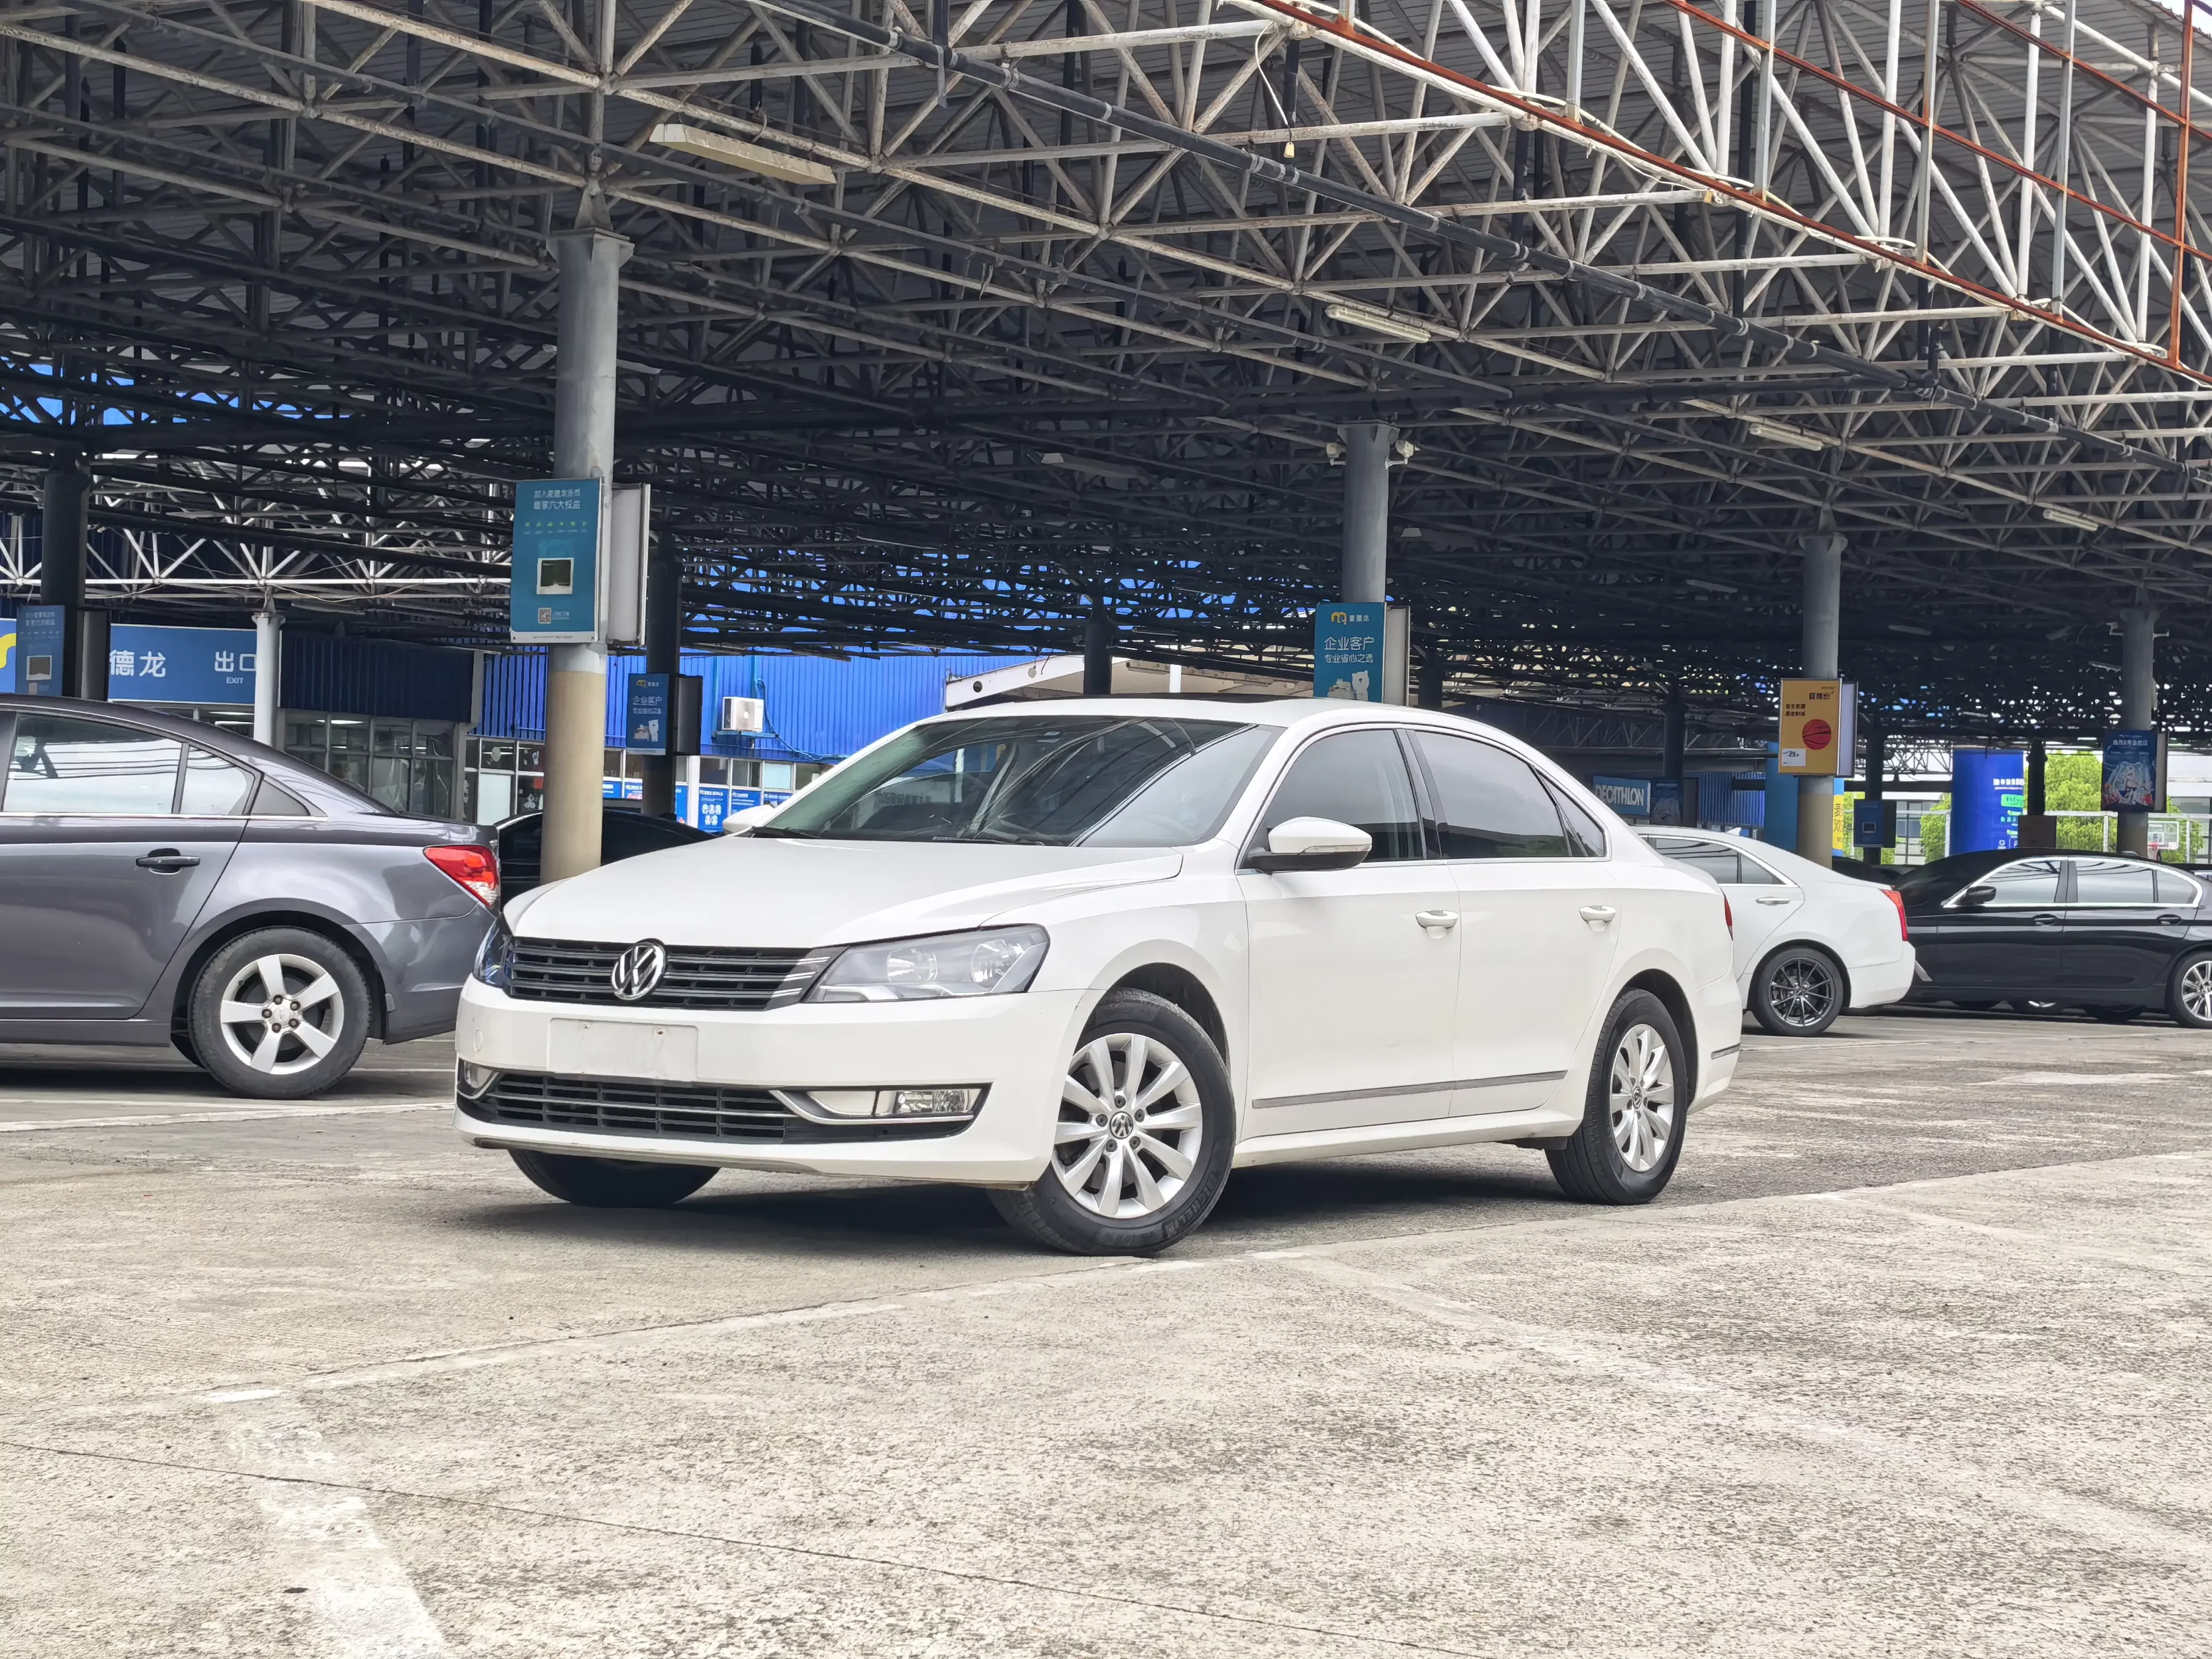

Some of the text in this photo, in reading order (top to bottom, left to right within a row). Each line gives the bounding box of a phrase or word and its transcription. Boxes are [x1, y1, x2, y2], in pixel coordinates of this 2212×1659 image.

[1324, 636, 1374, 650] 企业客户
[110, 650, 166, 677] 德龙
[214, 650, 256, 672] 出口
[1595, 784, 1644, 806] DECATHLON
